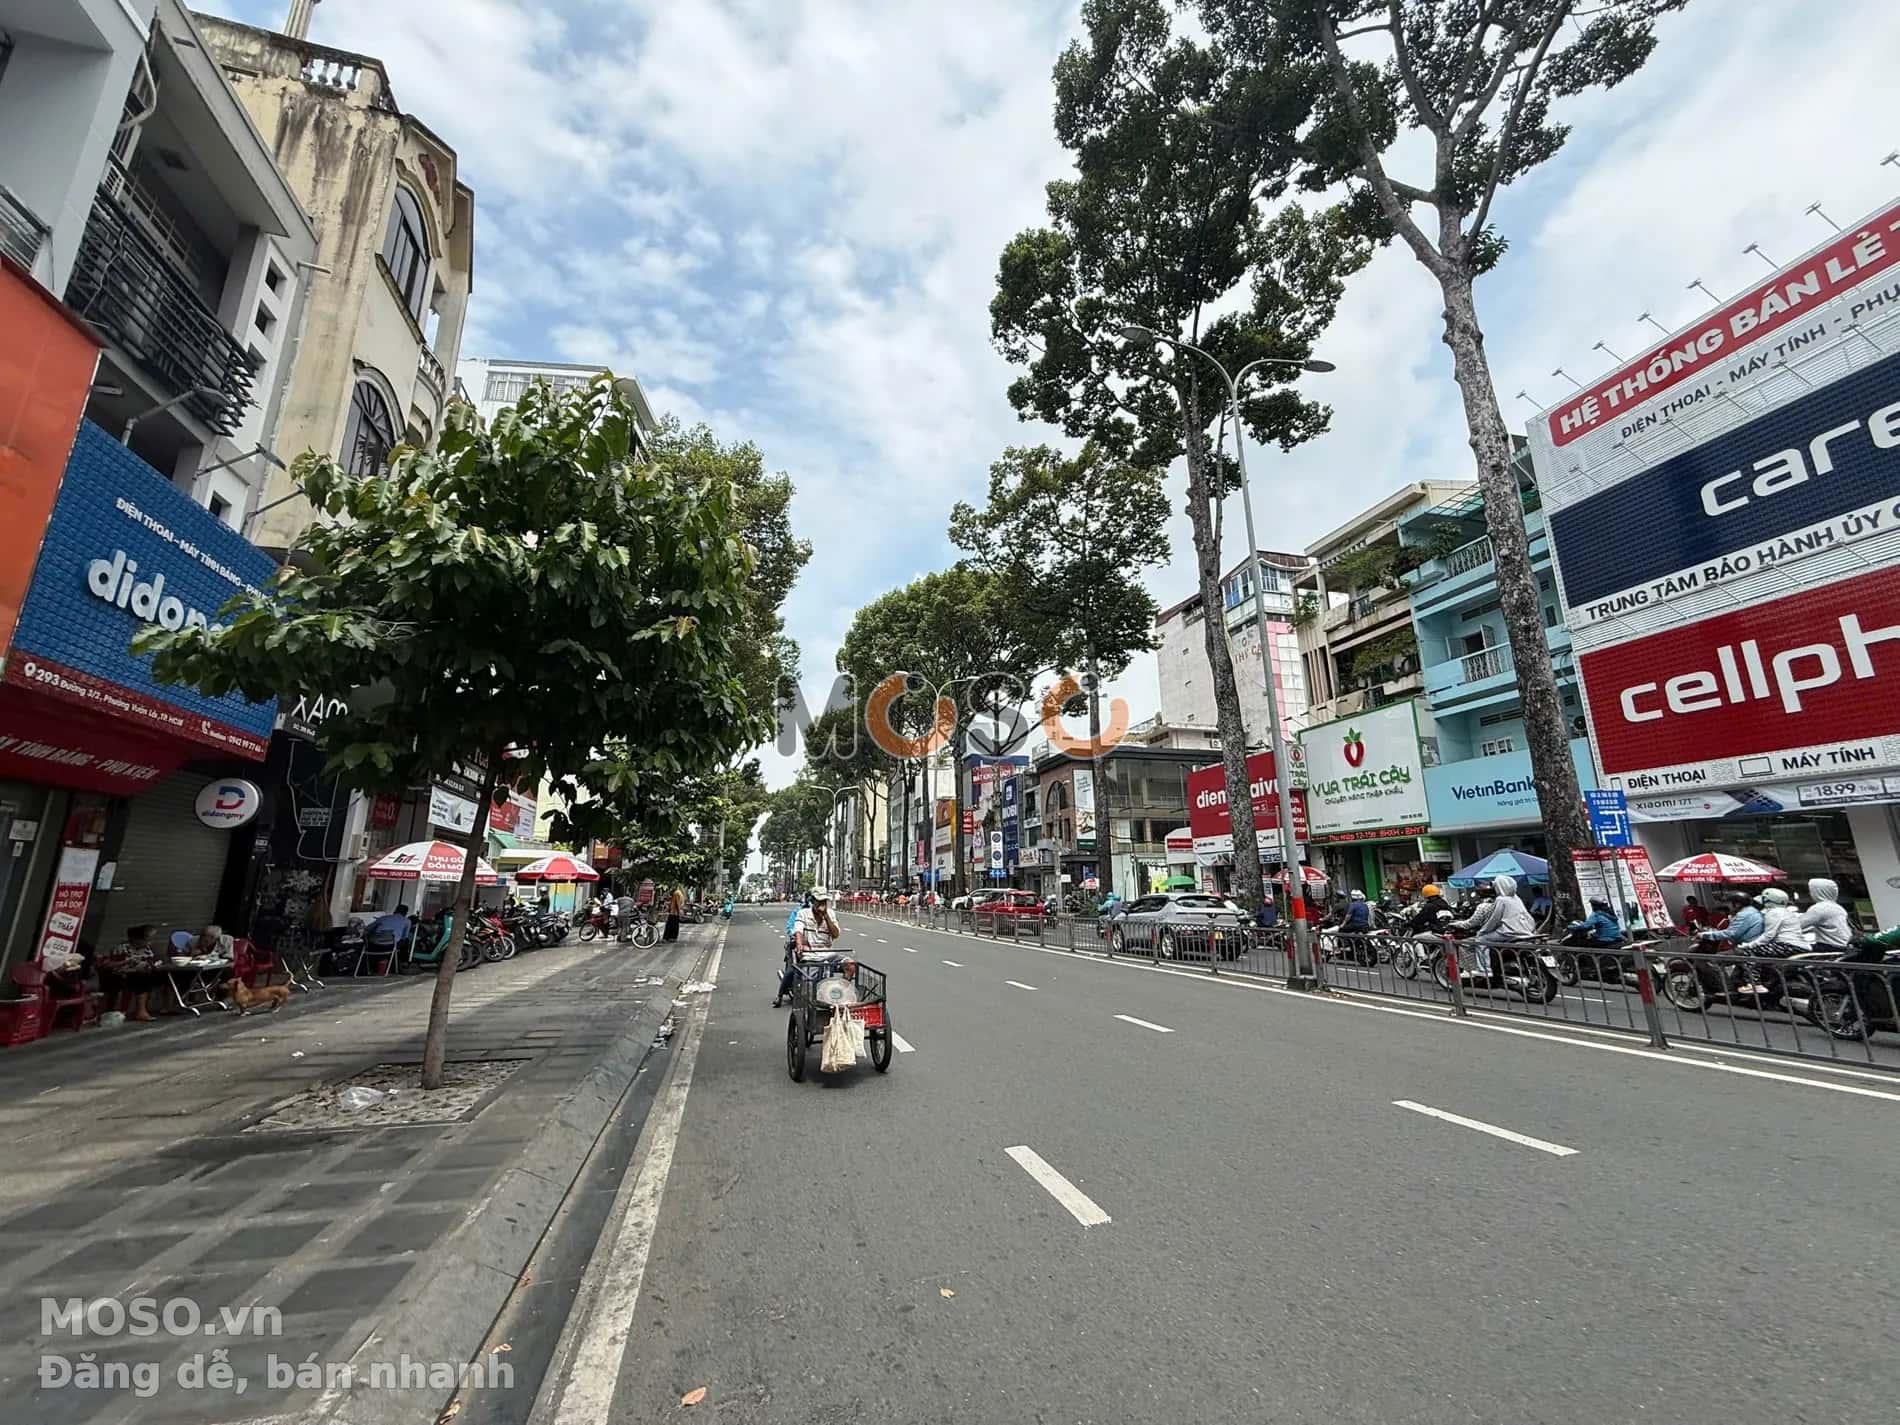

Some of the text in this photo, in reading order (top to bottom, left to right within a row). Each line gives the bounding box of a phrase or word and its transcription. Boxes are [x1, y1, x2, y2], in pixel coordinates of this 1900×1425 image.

[1560, 231, 1887, 434] HỆ THỐNG BÁN LẺ
[1621, 413, 1658, 439] ĐIỆN
[1661, 383, 1710, 416] THOẠI
[1729, 352, 1769, 384] MÁY
[1774, 324, 1826, 359] TÍNH
[116, 497, 143, 522] ĐIỆN
[143, 514, 174, 543] THOẠI
[179, 539, 200, 559] MÁY
[1586, 590, 1648, 620] TRUNG
[1651, 569, 1699, 599] TÂM
[1703, 552, 1751, 591] BẢO
[1756, 524, 1835, 567] HÀNH
[1841, 501, 1882, 536] ỦY
[88, 550, 224, 632] didon
[36, 668, 60, 687] 293
[60, 679, 86, 697] Đường
[1312, 764, 1412, 797] VUA TRÁI CÂY
[1628, 745, 1876, 790] ĐIỆN THOẠI MÁY TÍNH
[1814, 783, 1856, 797] 18.99
[428, 855, 449, 863] THU
[447, 862, 464, 870] MỚ
